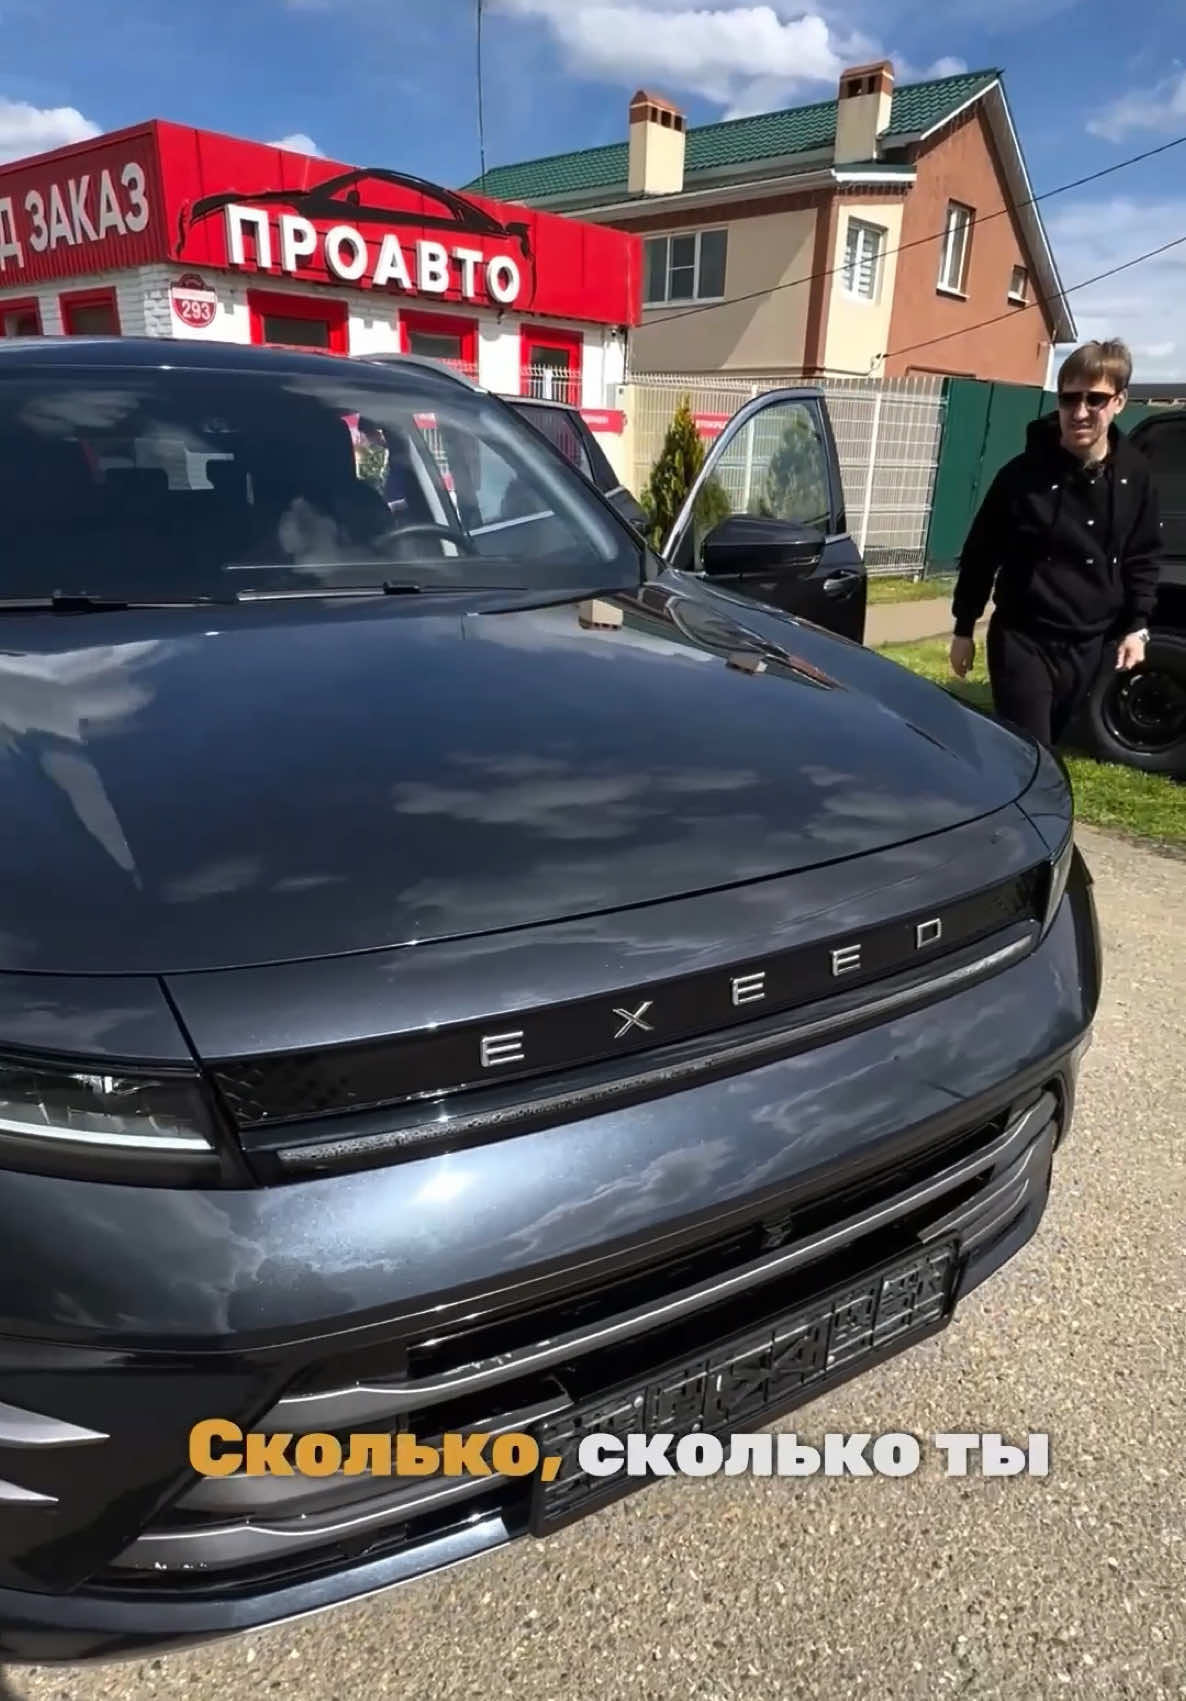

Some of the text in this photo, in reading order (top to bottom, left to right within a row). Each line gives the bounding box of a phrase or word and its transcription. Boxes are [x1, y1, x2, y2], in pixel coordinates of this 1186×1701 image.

[25, 162, 149, 252] ЗАКАЗ
[225, 203, 520, 304] ПРОАВТО
[182, 300, 211, 320] 293
[480, 917, 942, 1068] EXEED
